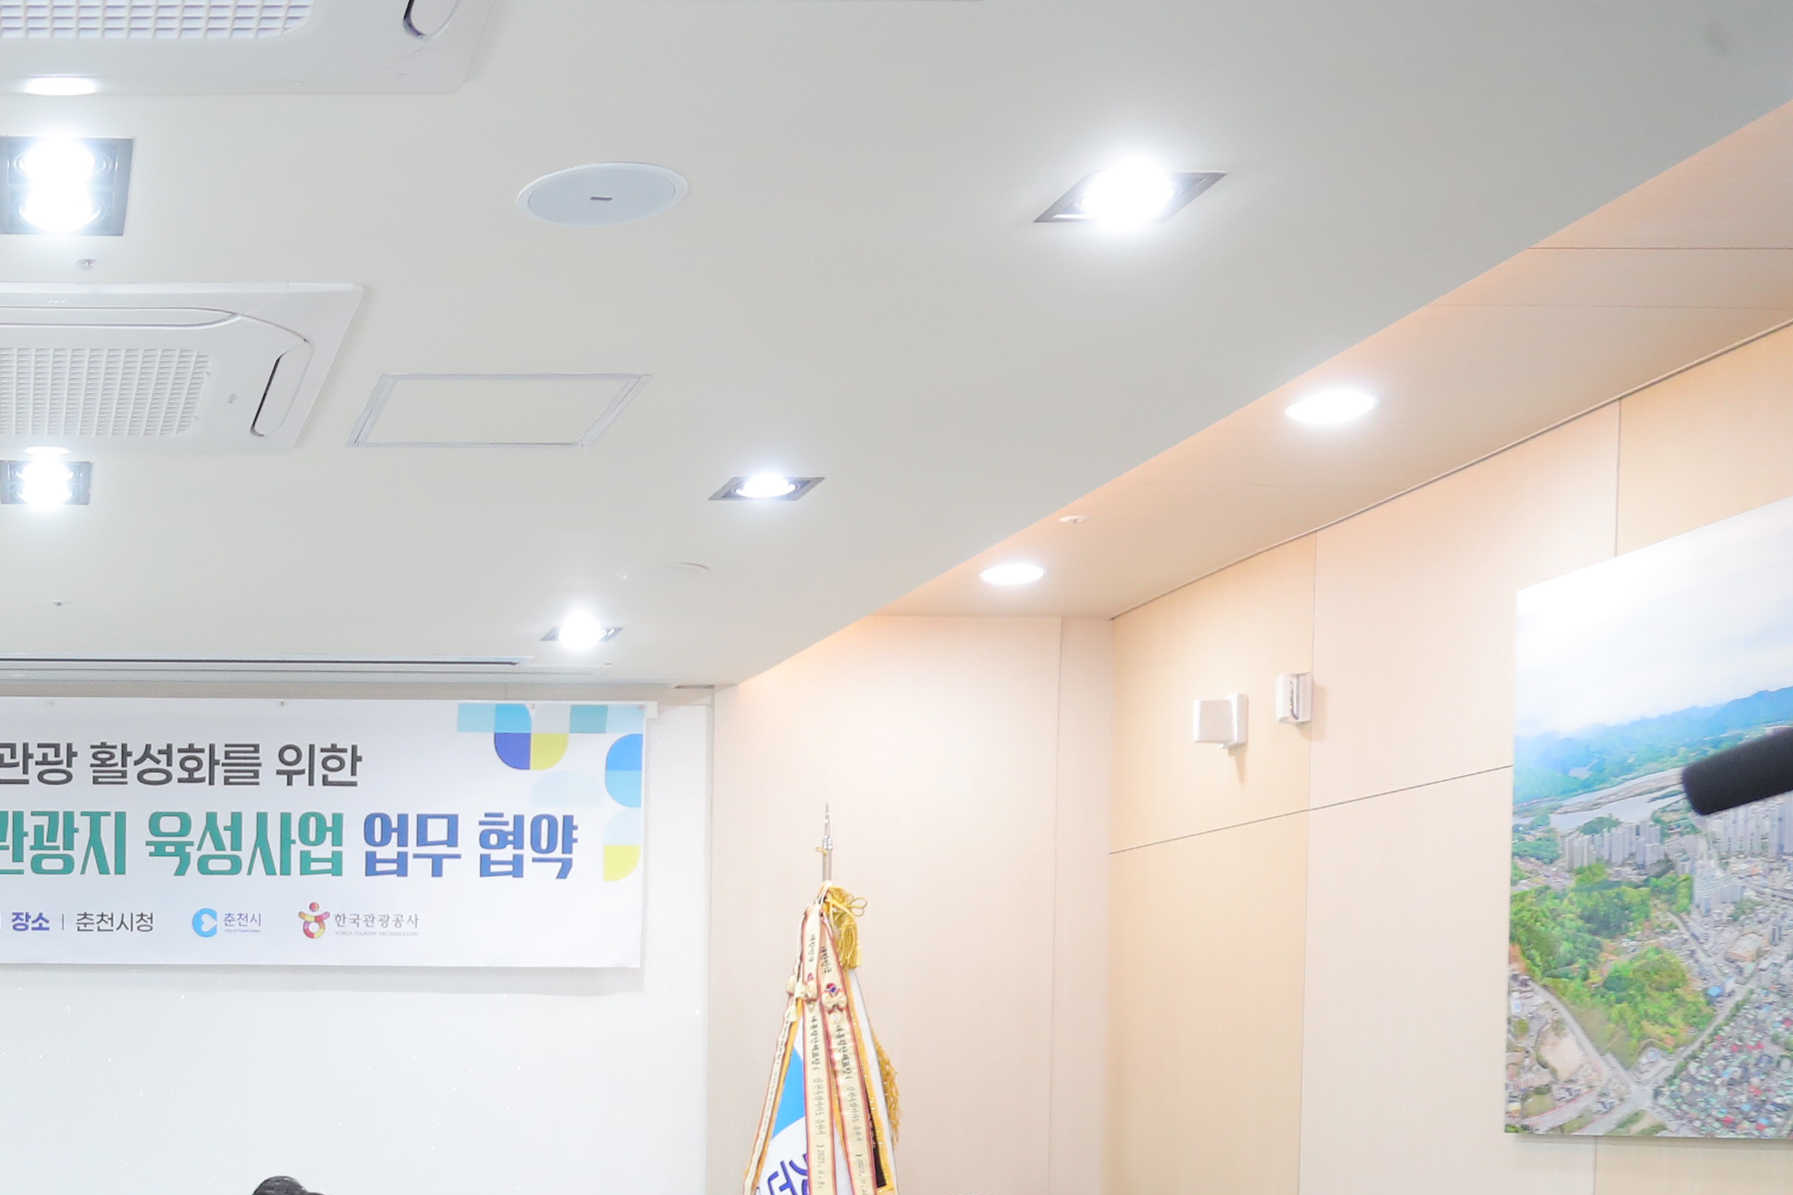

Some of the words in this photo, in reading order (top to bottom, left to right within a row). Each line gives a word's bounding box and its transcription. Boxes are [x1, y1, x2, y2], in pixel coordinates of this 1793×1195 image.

[89, 741, 263, 787] 활성화를
[275, 742, 363, 788] 위한
[144, 810, 344, 877] 육성사업
[363, 811, 462, 878] 업무
[478, 811, 579, 880] 협약
[11, 911, 51, 932] 장소
[76, 912, 154, 933] 춘천시청
[223, 912, 262, 927] 춘천시
[334, 912, 419, 929] 한국관광공사
